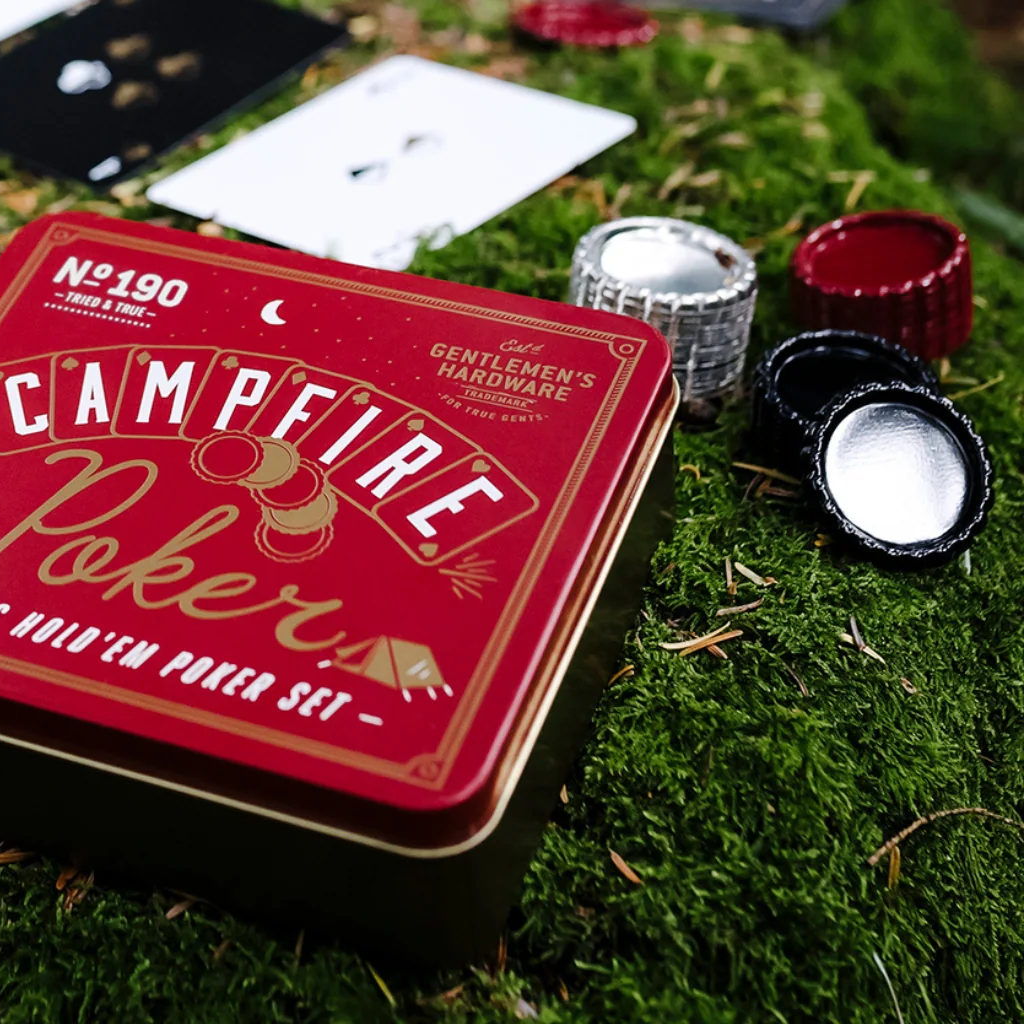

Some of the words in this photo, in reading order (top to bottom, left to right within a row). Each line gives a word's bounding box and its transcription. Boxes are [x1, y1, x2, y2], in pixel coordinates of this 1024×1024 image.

[64, 291, 101, 309] TRIED
[102, 299, 112, 311] &
[429, 342, 597, 389] GENTLEMEN'S
[437, 362, 573, 402] HARDWARE
[464, 389, 528, 408] TRADEMARK
[465, 406, 496, 420] TRUE
[3, 361, 505, 539] CAMPFIRE
[9, 611, 160, 670] HOLD'EM
[159, 650, 276, 702] POKER
[277, 681, 352, 721] SET
